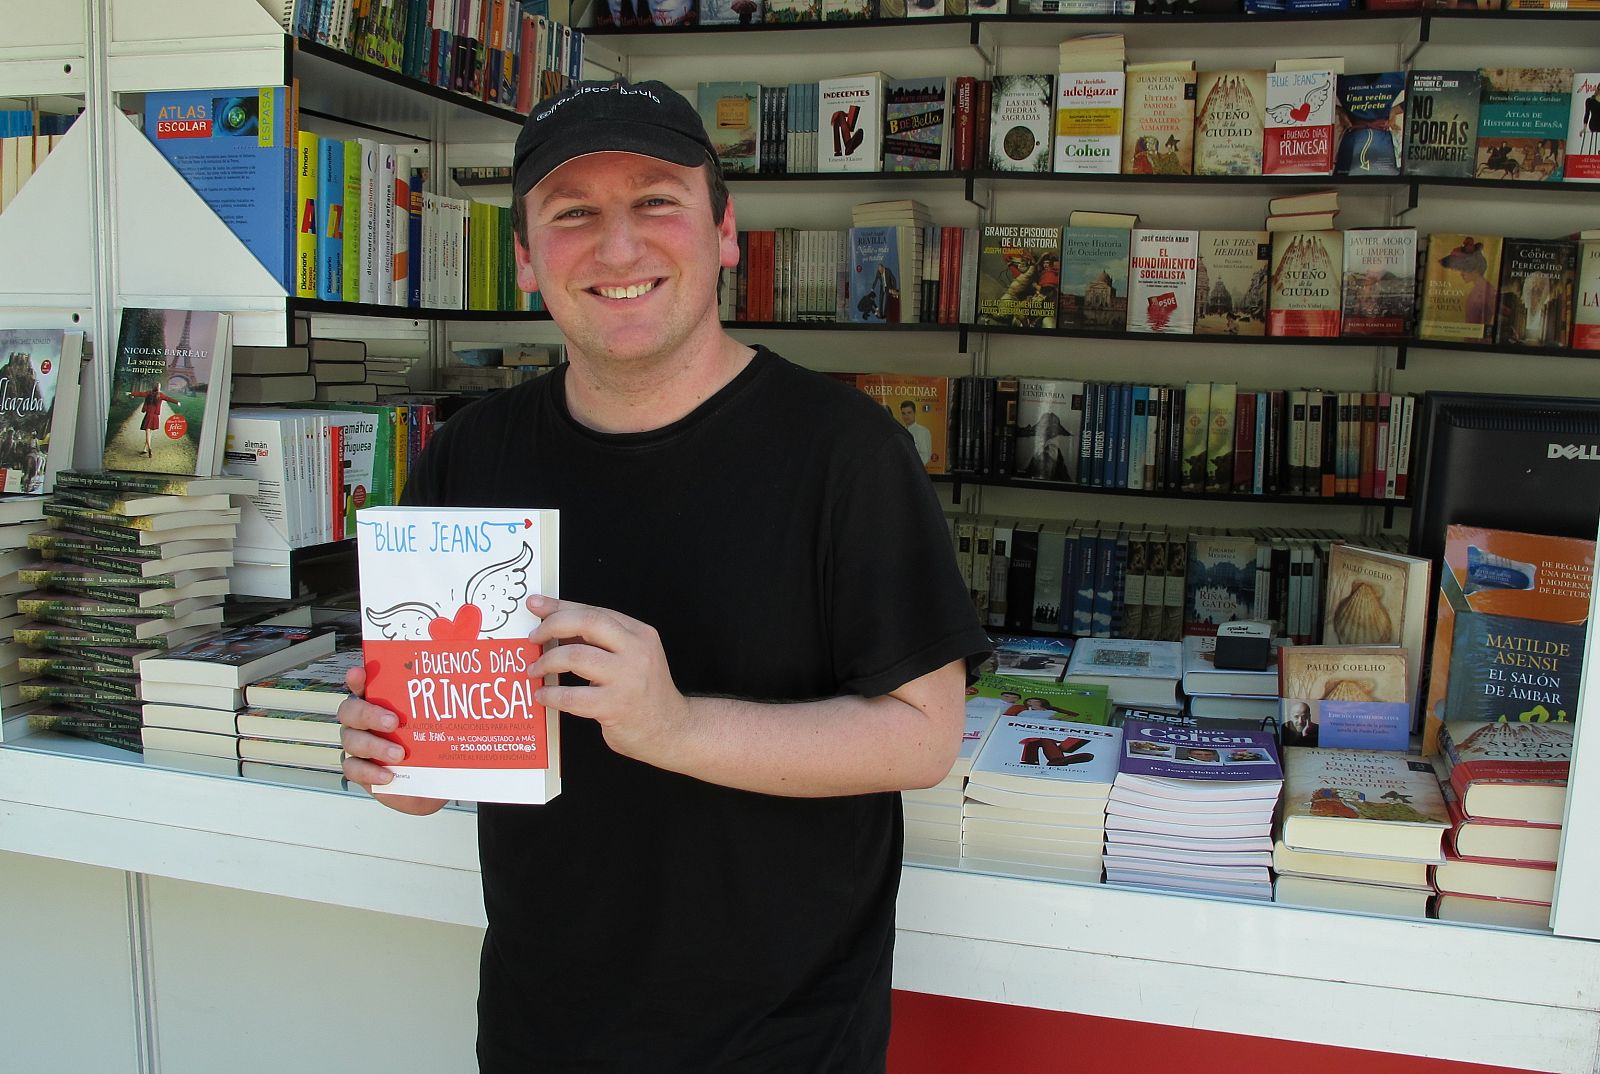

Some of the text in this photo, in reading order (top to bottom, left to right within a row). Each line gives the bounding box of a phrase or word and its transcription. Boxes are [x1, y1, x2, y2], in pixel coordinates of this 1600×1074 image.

[1272, 74, 1316, 88] BLUE JEANS
[824, 90, 870, 99] INDECENTES
[1063, 85, 1118, 98] adelgazar
[1347, 93, 1392, 102] Una vecina
[158, 105, 206, 119] ATLAS
[1351, 102, 1385, 112] perfecta
[1412, 95, 1433, 119] NO
[262, 90, 271, 141] ESPASA
[1210, 108, 1249, 120] SUEÑO
[1505, 110, 1543, 119] ATLAS DE
[158, 121, 207, 133] ESCOLAR
[890, 120, 898, 133] B
[912, 113, 940, 128] Bella
[1483, 119, 1563, 129] HISTORIA DE ESPAÑA
[1206, 128, 1252, 138] CIUDAD
[1409, 114, 1469, 145] PODRÁS
[1065, 144, 1110, 157] Cohen
[1280, 140, 1327, 156] PRINCESA!
[1408, 146, 1468, 161] ESCONDERTE
[368, 220, 372, 230] de
[386, 220, 390, 229] de
[985, 227, 1018, 237] GRANDES
[1020, 227, 1058, 238] EPISODIOS
[1001, 238, 1057, 248] DE LA HISTORIA
[1092, 240, 1122, 248] Historia
[1350, 237, 1411, 246] JAVIER MORO
[1067, 248, 1076, 256] de
[1160, 248, 1168, 257] EL
[1368, 248, 1404, 256] IMPERIO
[1132, 257, 1195, 270] HUNDIMIENTO
[1140, 270, 1185, 279] SOCIALISTA
[1285, 269, 1327, 279] SUEÑO
[1282, 288, 1329, 297] CIUDAD
[124, 347, 207, 358] NICOLAS BARREAU
[127, 357, 166, 366] La sonrisa
[0, 377, 43, 417] lcazaba
[864, 385, 937, 397] SABER COCINAR
[344, 421, 373, 434] amática
[245, 440, 267, 449] alemán
[344, 442, 371, 455] tuguesa
[1547, 443, 1600, 460] DELL
[373, 521, 491, 553] BLUE JEANS
[1343, 563, 1392, 581] PAULO COELHO
[1555, 562, 1589, 572] REGALO
[1541, 569, 1593, 581] UNA PRÁCTI
[1546, 578, 1589, 590] MODERNA
[1200, 590, 1222, 600] RIÑA
[1202, 601, 1237, 609] GATOS
[1486, 634, 1570, 657] MATILDE
[415, 647, 527, 675] ¡BUENOS DÍAS
[1494, 651, 1558, 671] ASENSI
[1488, 669, 1560, 688] EL SALÓN
[407, 677, 534, 721] PRINCESA!
[1485, 685, 1562, 705] DE ÁMBAR
[491, 723, 508, 731] PARA
[1007, 722, 1114, 737] INDECENTES
[413, 731, 426, 741] BLUE
[429, 732, 446, 742] JEANS
[522, 734, 536, 742] MÁS
[1140, 728, 1253, 743] Cohen
[494, 744, 536, 752] LECTOR@S
[1485, 750, 1568, 758] CIUDA
